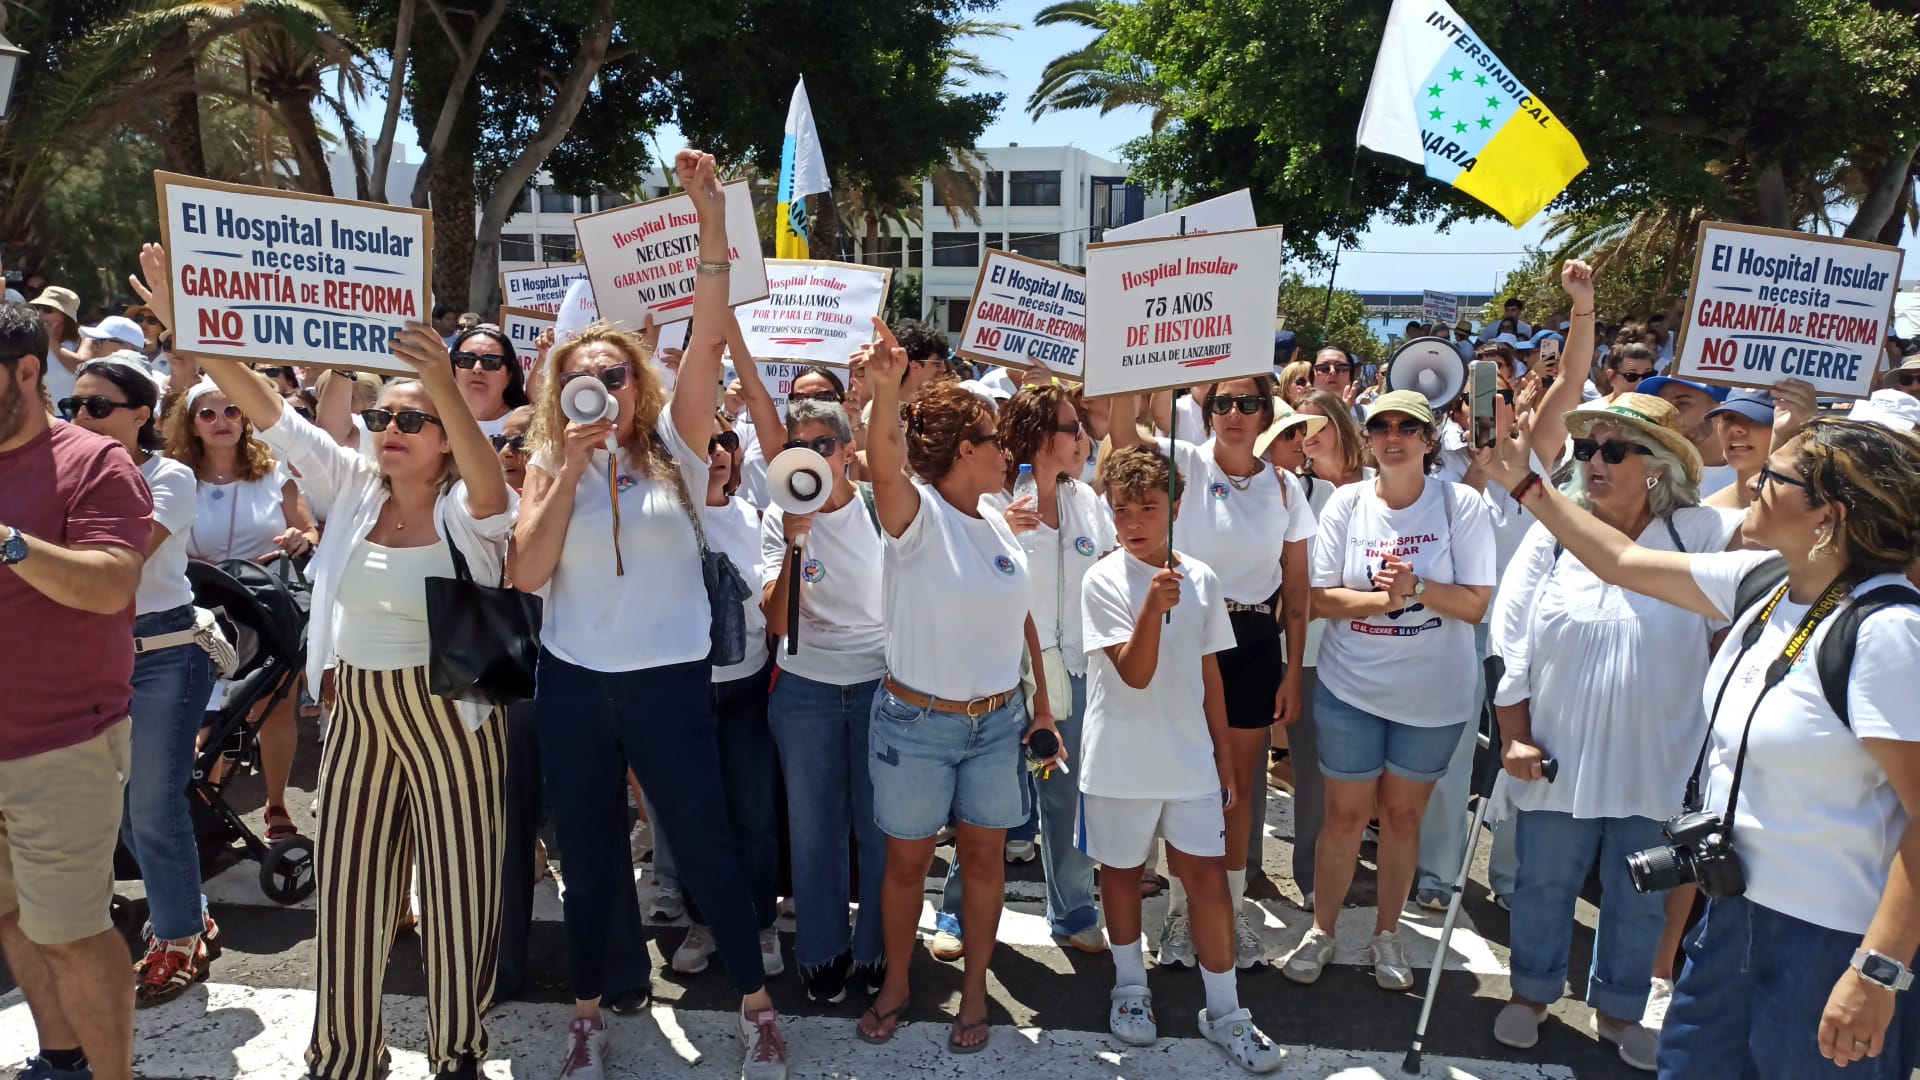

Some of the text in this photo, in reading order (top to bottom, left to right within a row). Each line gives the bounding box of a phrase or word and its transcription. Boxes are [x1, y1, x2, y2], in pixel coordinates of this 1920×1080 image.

[1425, 11, 1549, 129] INTERSINDICAL
[182, 202, 414, 257] El Hospital Insular
[612, 213, 700, 249] Hospital Insu
[252, 250, 346, 275] necesita
[668, 260, 684, 275] DE
[1121, 255, 1239, 291] Hospital Insular
[1711, 244, 1889, 292] El Hospital Insular
[181, 265, 416, 317] GARANTÍA DE REFORMA
[510, 278, 520, 292] El
[522, 275, 559, 292] Hospital
[638, 286, 655, 304] NO
[658, 281, 676, 299] UN
[810, 275, 847, 291] Insular
[990, 265, 1085, 306] El Hospital Insu
[1758, 285, 1830, 308] necesita
[769, 293, 840, 309] TRABAJAMOS
[1018, 295, 1065, 316] necesita
[1145, 291, 1213, 318] 75 AÑOS
[198, 308, 244, 340] NO
[253, 315, 294, 345] UN
[512, 323, 525, 340] El
[751, 325, 848, 339] MERECEMOS SER ESCUCHADOS
[752, 309, 853, 325] POR Y PARA EL PUEBLO
[977, 301, 1085, 343] GARANTÍA DE REFORM
[1126, 314, 1233, 348] DE HISTORIA
[1697, 299, 1878, 346] GARANTÍA DE REFORMA
[976, 327, 1080, 366] NO UN CIERRE
[1122, 342, 1232, 367] EN LA ISLA DE LANZAROTE
[1700, 338, 1862, 382] NO UN CIERRE
[766, 364, 777, 377] NO
[780, 365, 789, 378] ES
[1380, 533, 1439, 548] HOSPITAL
[1760, 585, 1788, 621] Nikon
[1785, 619, 1816, 658] Nikon
